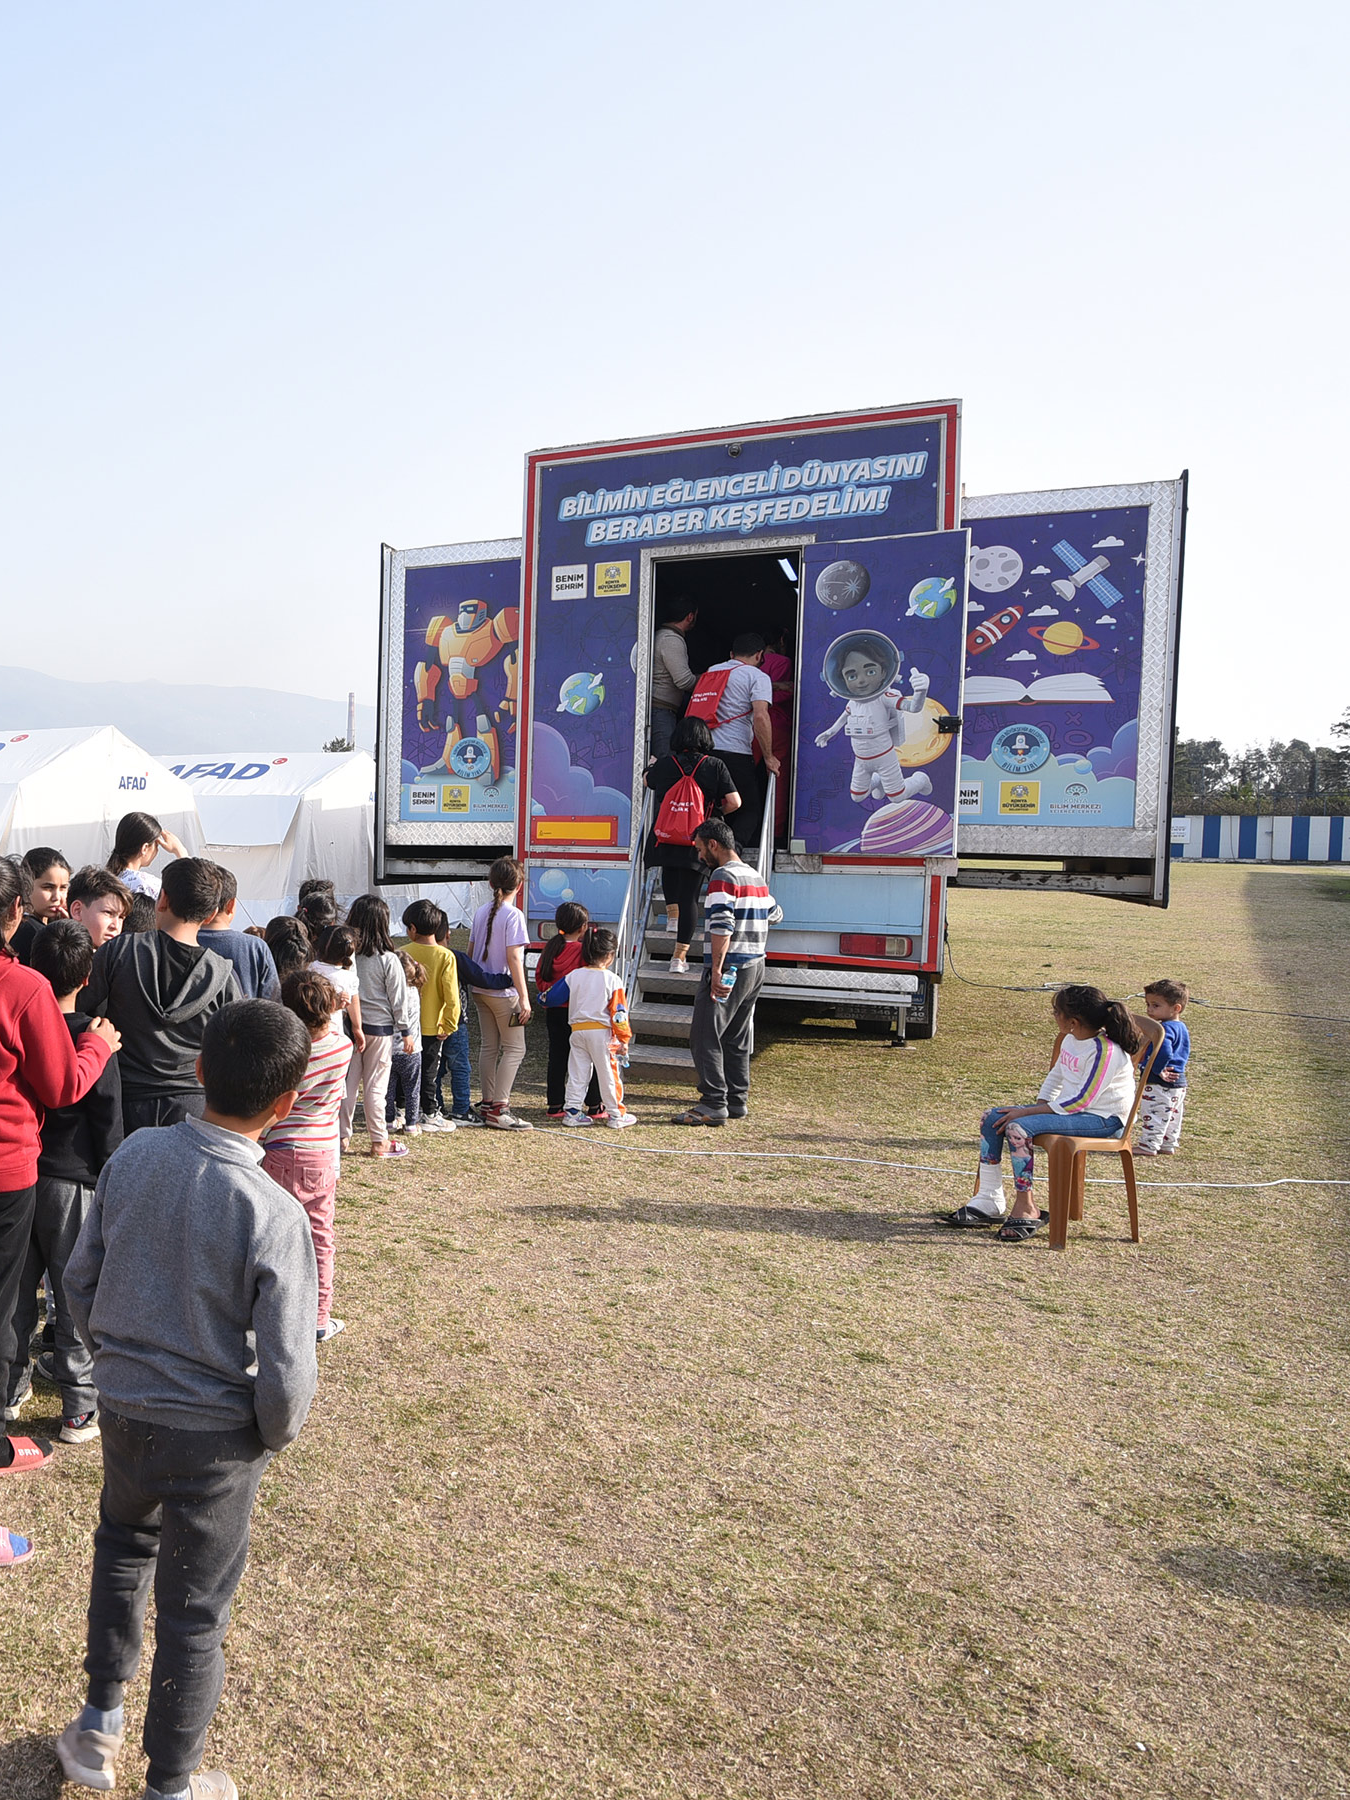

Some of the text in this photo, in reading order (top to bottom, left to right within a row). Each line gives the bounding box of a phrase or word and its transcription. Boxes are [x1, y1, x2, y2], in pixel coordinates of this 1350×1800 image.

[562, 454, 926, 518] BİLİMİN EĞLENCELİ DÜNYASINI
[589, 487, 889, 542] BERABER KEŞFEDELİM!
[555, 573, 584, 583] BENİM
[555, 582, 584, 591] ŞEHRİM
[118, 776, 147, 790] AFAD
[412, 791, 435, 799] BENİM
[959, 789, 979, 797] NİM
